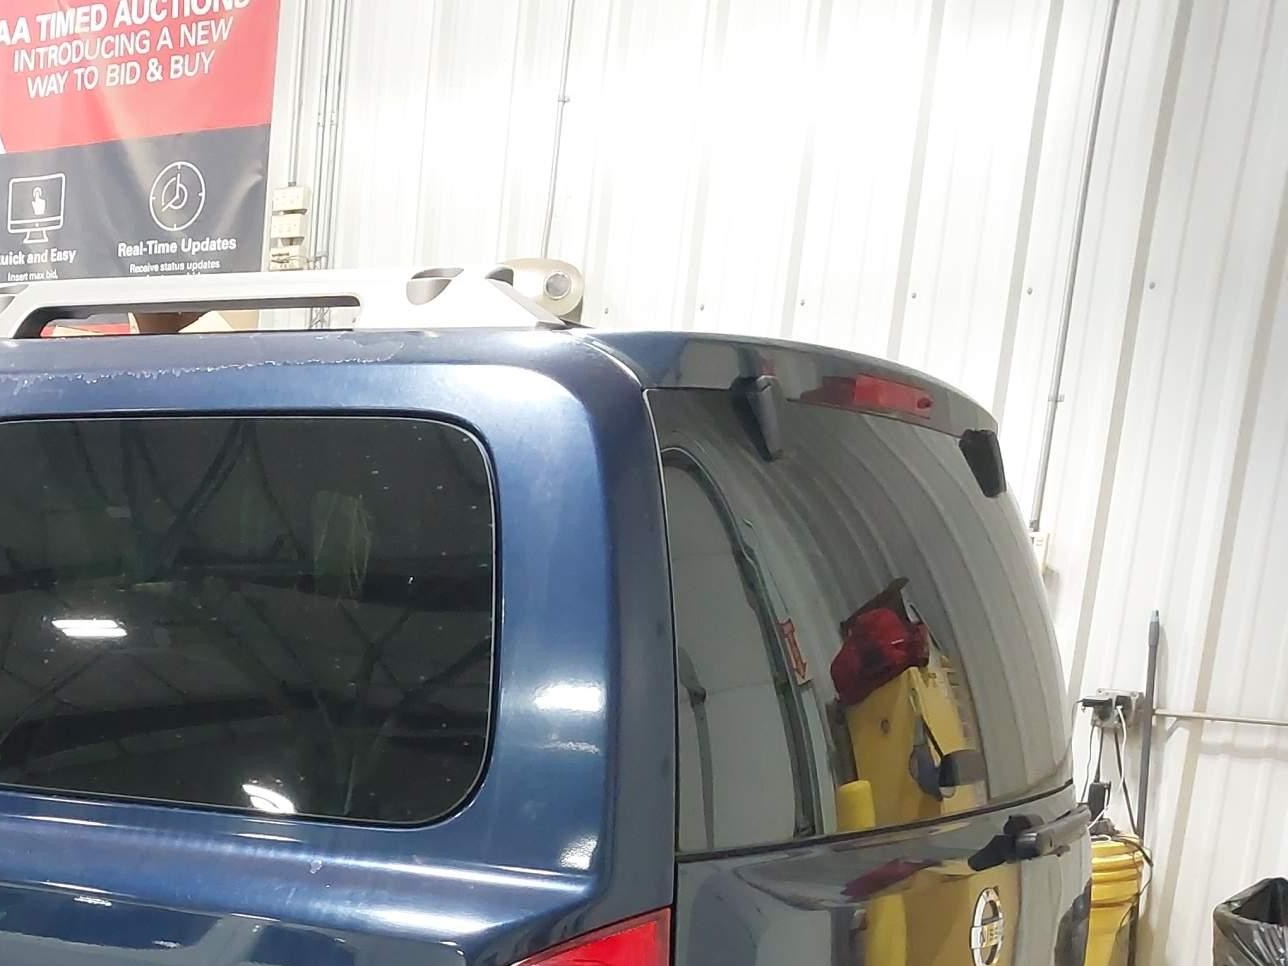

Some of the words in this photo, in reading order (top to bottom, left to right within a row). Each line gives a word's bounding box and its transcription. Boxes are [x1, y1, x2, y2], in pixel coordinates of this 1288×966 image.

[36, 3, 108, 41] TIMED
[14, 29, 151, 72] INTRODUCING
[156, 26, 173, 51] A
[179, 16, 233, 48] NEW
[27, 71, 69, 98] WAY
[74, 65, 99, 91] TO
[105, 61, 141, 86] BID
[146, 58, 162, 82] &
[169, 49, 215, 79] BUY
[26, 249, 49, 264] and
[50, 248, 76, 263] Easy
[117, 239, 178, 257] Real-Time
[180, 237, 237, 255] Updates
[7, 271, 28, 282] Insert
[129, 263, 159, 274] Receive
[160, 261, 185, 272] status
[186, 260, 221, 271] updates
